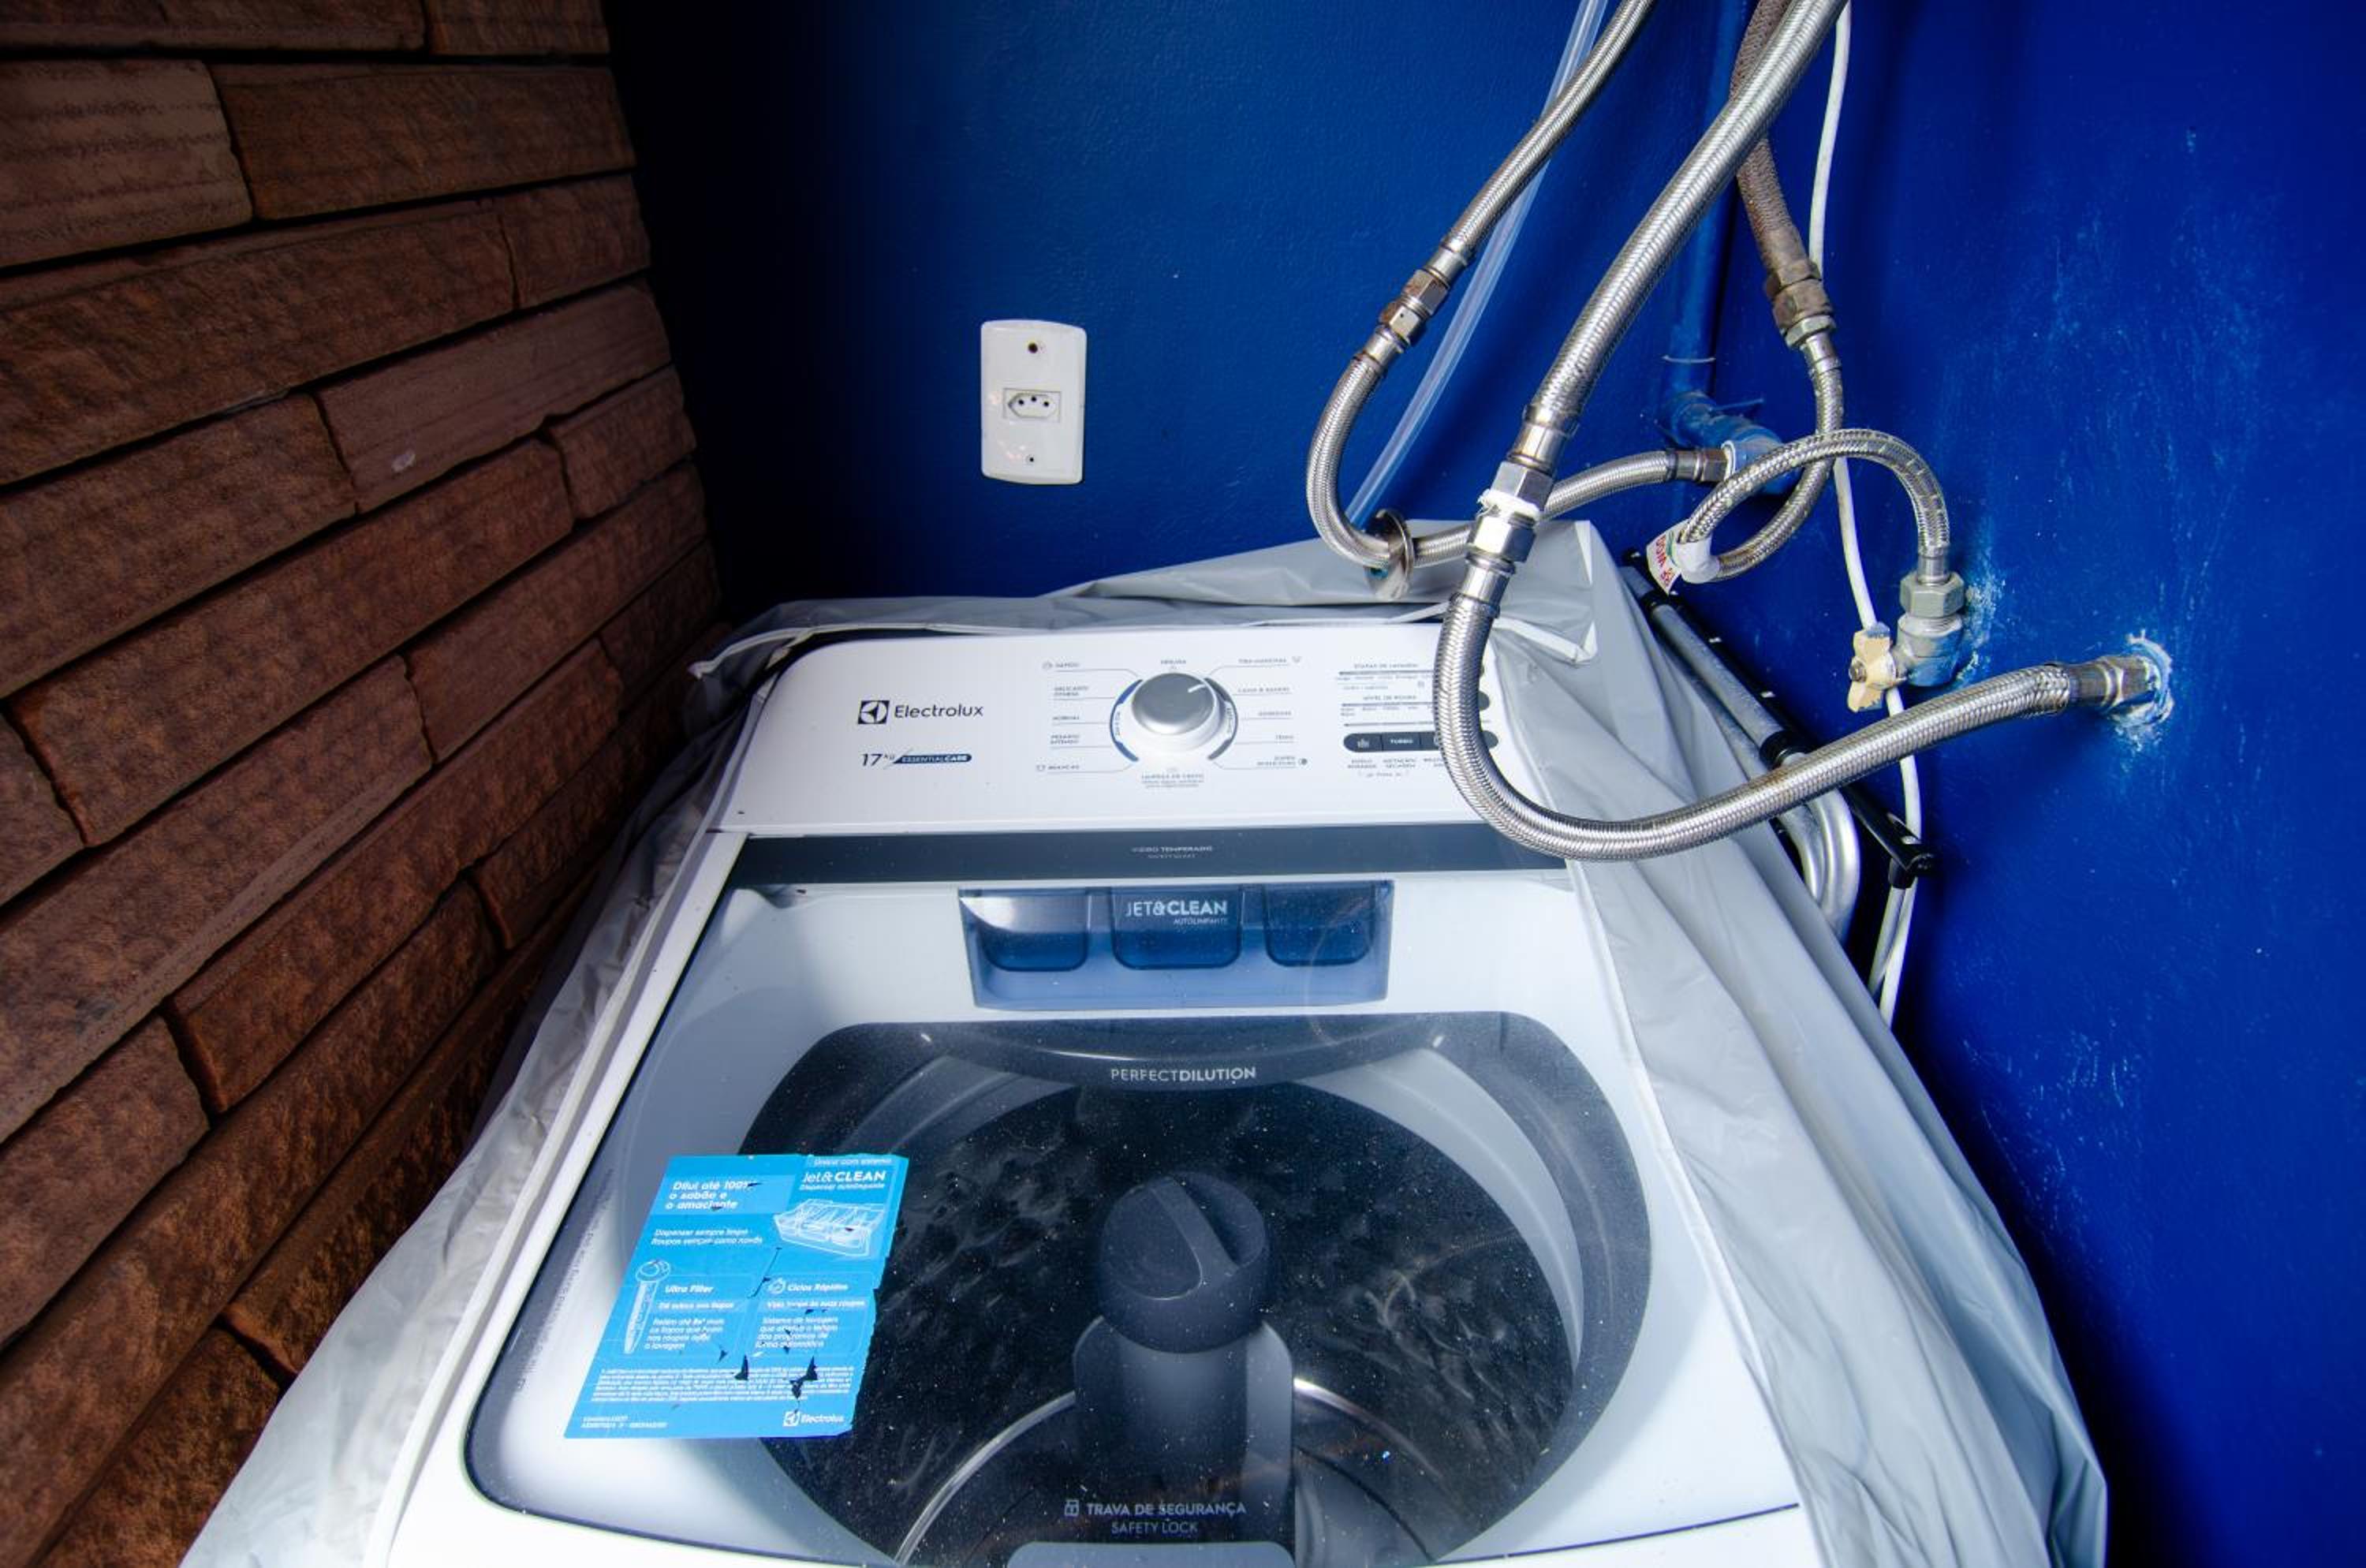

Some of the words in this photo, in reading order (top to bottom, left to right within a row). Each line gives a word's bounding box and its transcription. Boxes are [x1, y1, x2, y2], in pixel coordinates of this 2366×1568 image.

[894, 704, 983, 719] Electrolux
[862, 753, 883, 767] 17
[1125, 900, 1228, 917] JET&CLEAN
[1110, 1066, 1256, 1081] PERFECTDILUTION
[701, 1180, 721, 1190] até
[680, 1190, 717, 1200] sabão
[800, 1414, 845, 1424] Electrolux
[1087, 1502, 1131, 1516] TRAVA
[1134, 1502, 1155, 1516] DE
[1158, 1500, 1247, 1518] SEGURANÇA
[1110, 1521, 1159, 1535] SAFETY
[1161, 1521, 1199, 1535] LOCK
